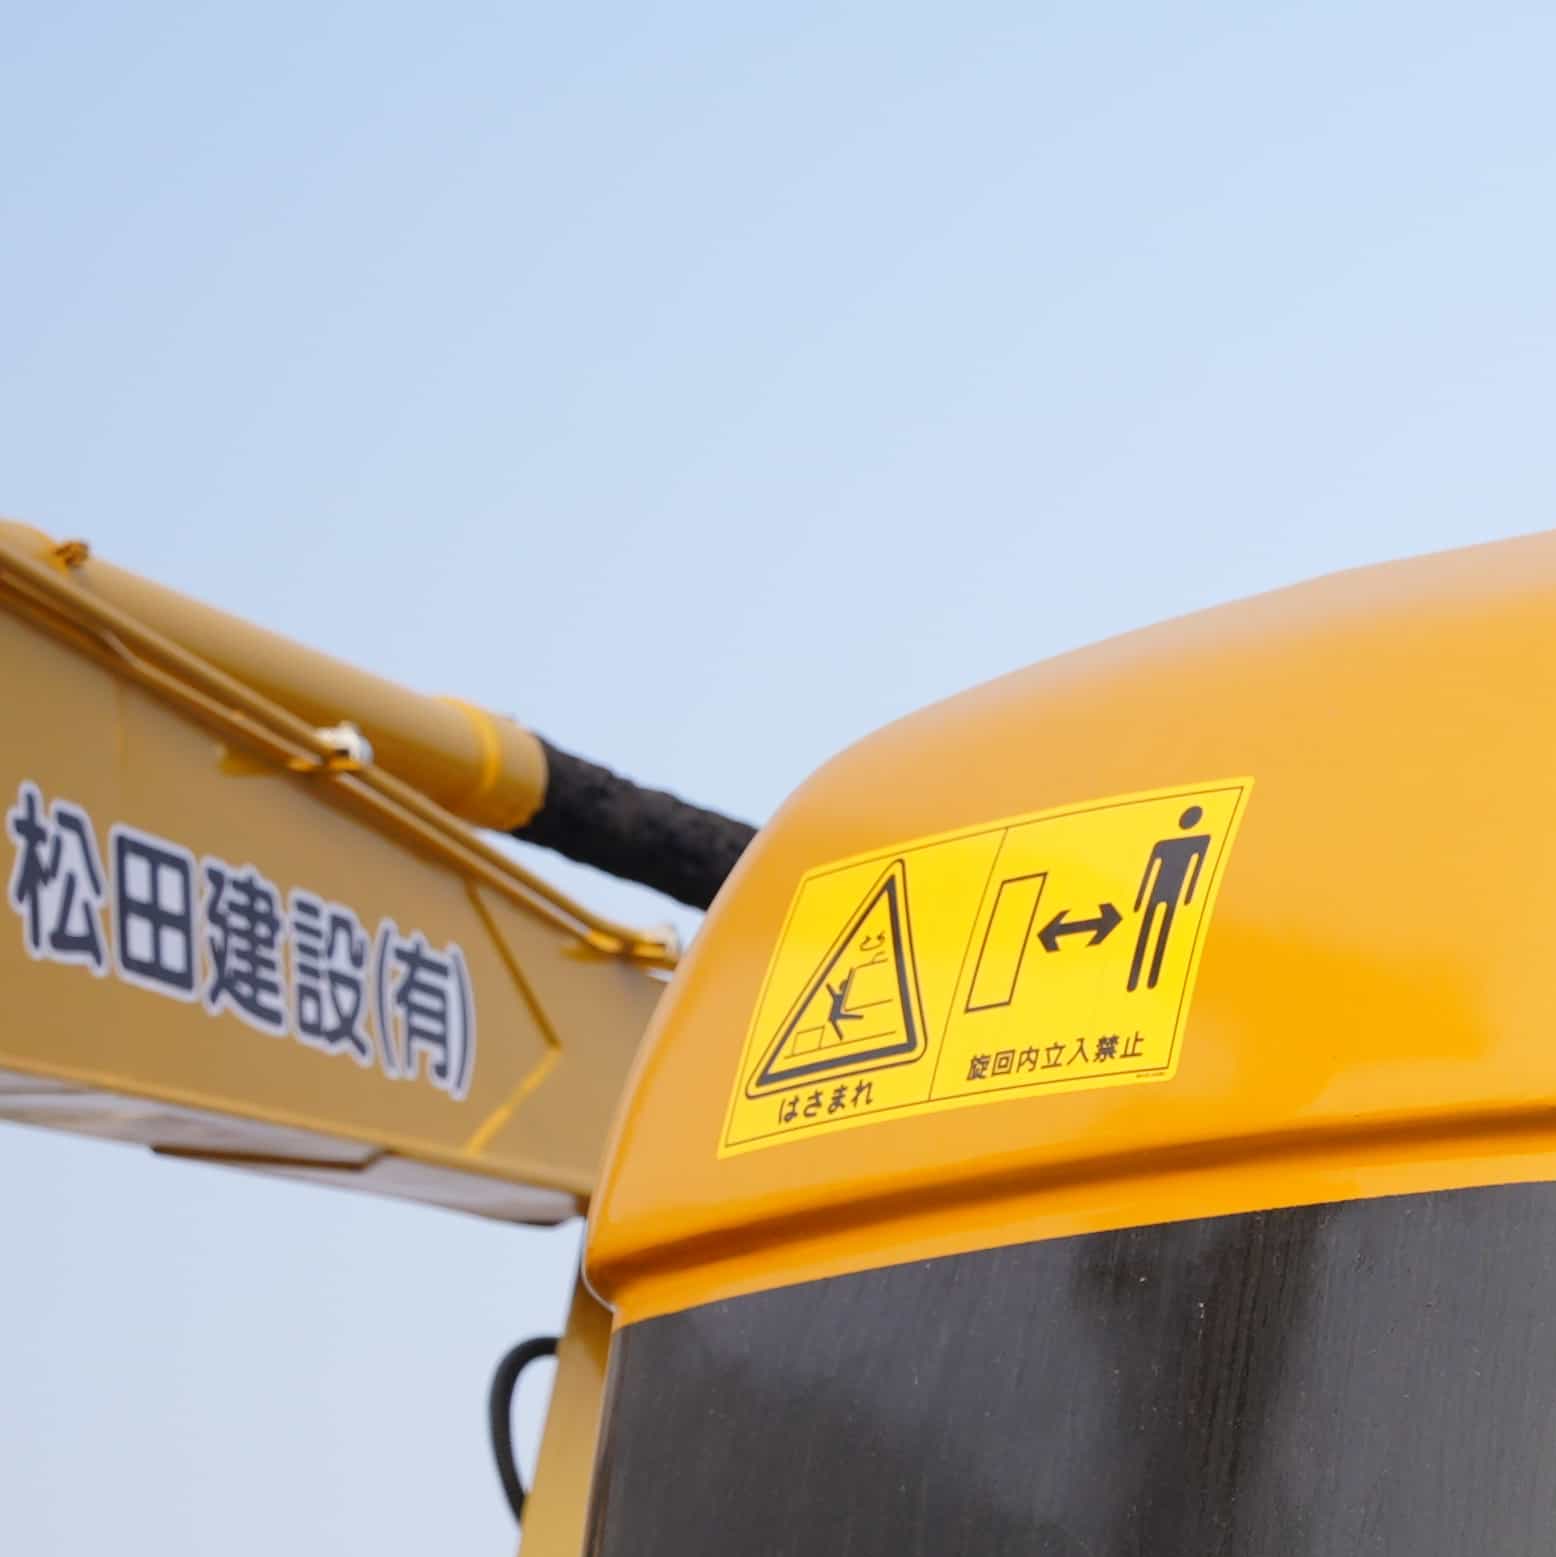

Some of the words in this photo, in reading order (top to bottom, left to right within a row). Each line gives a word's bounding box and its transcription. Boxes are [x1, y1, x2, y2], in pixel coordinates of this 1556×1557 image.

[966, 1031, 1145, 1081] 旋回内立入禁止
[778, 1079, 873, 1125] はさまれ
